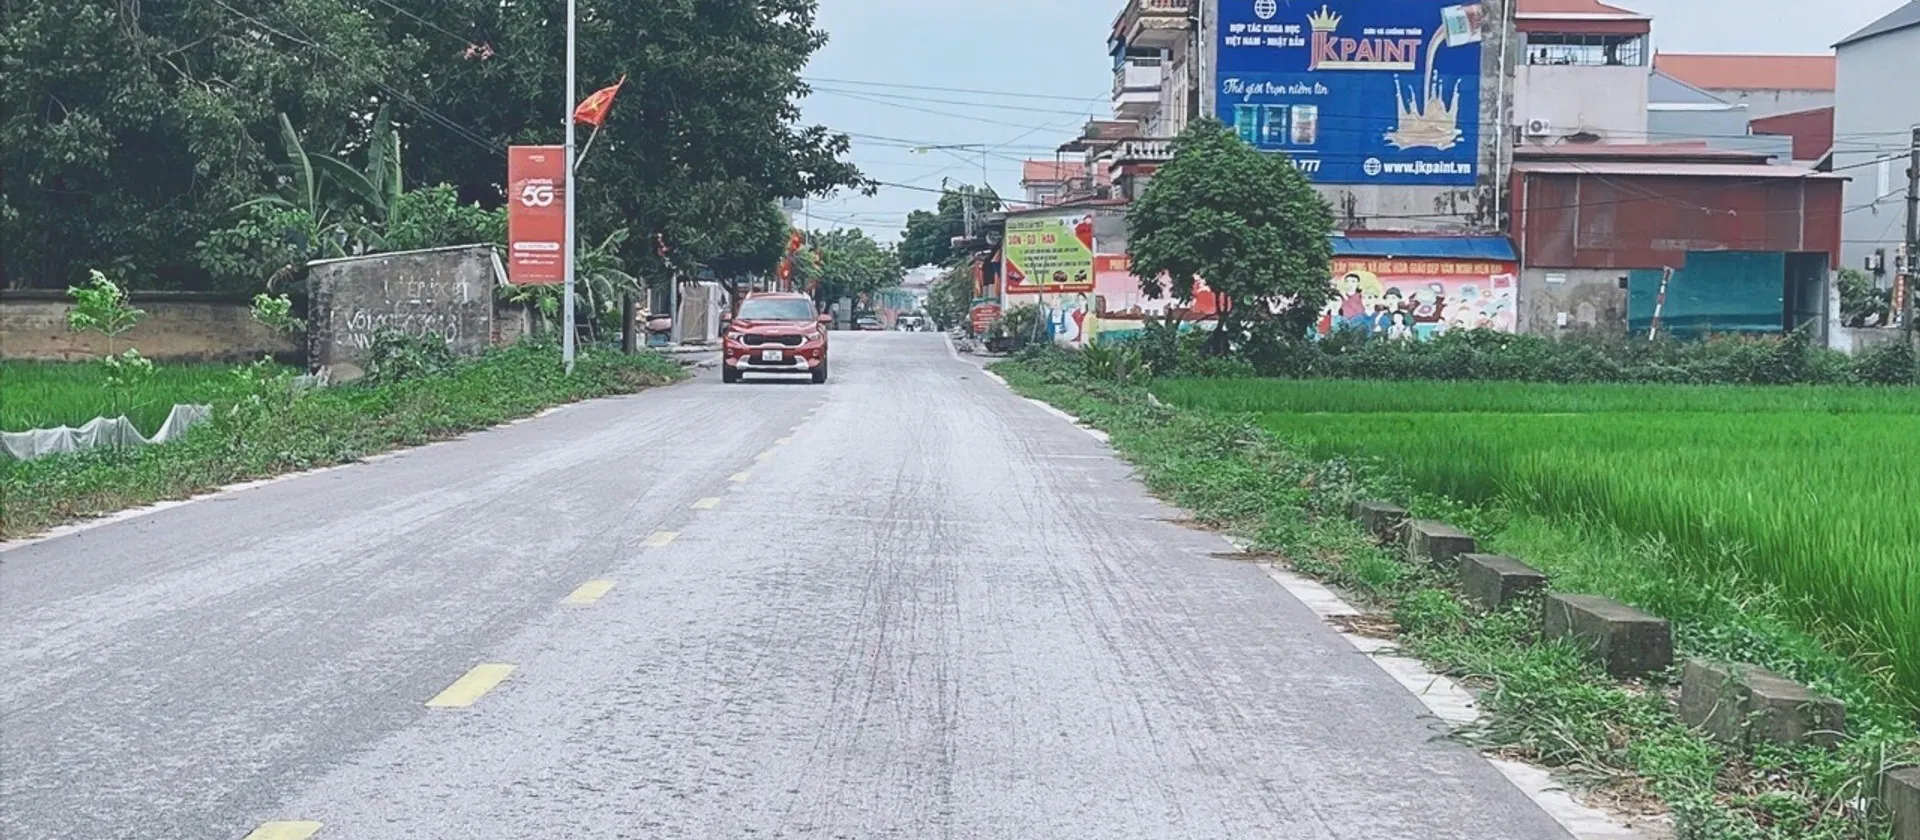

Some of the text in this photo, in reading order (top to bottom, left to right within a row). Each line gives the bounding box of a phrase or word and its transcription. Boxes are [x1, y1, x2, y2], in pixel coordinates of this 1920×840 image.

[1229, 22, 1301, 35] HỢP TÁC KHOA HỌC
[1225, 35, 1241, 47] VIỆT
[1242, 36, 1261, 46] NAM
[1267, 36, 1288, 48] NHẬT
[1288, 35, 1305, 46] BẢN
[1307, 31, 1422, 72] JKPAINT
[1222, 78, 1329, 102] Thế giới trọn niềm tin
[1383, 160, 1472, 175] www.jkpaint.vn
[521, 185, 554, 207] 5G
